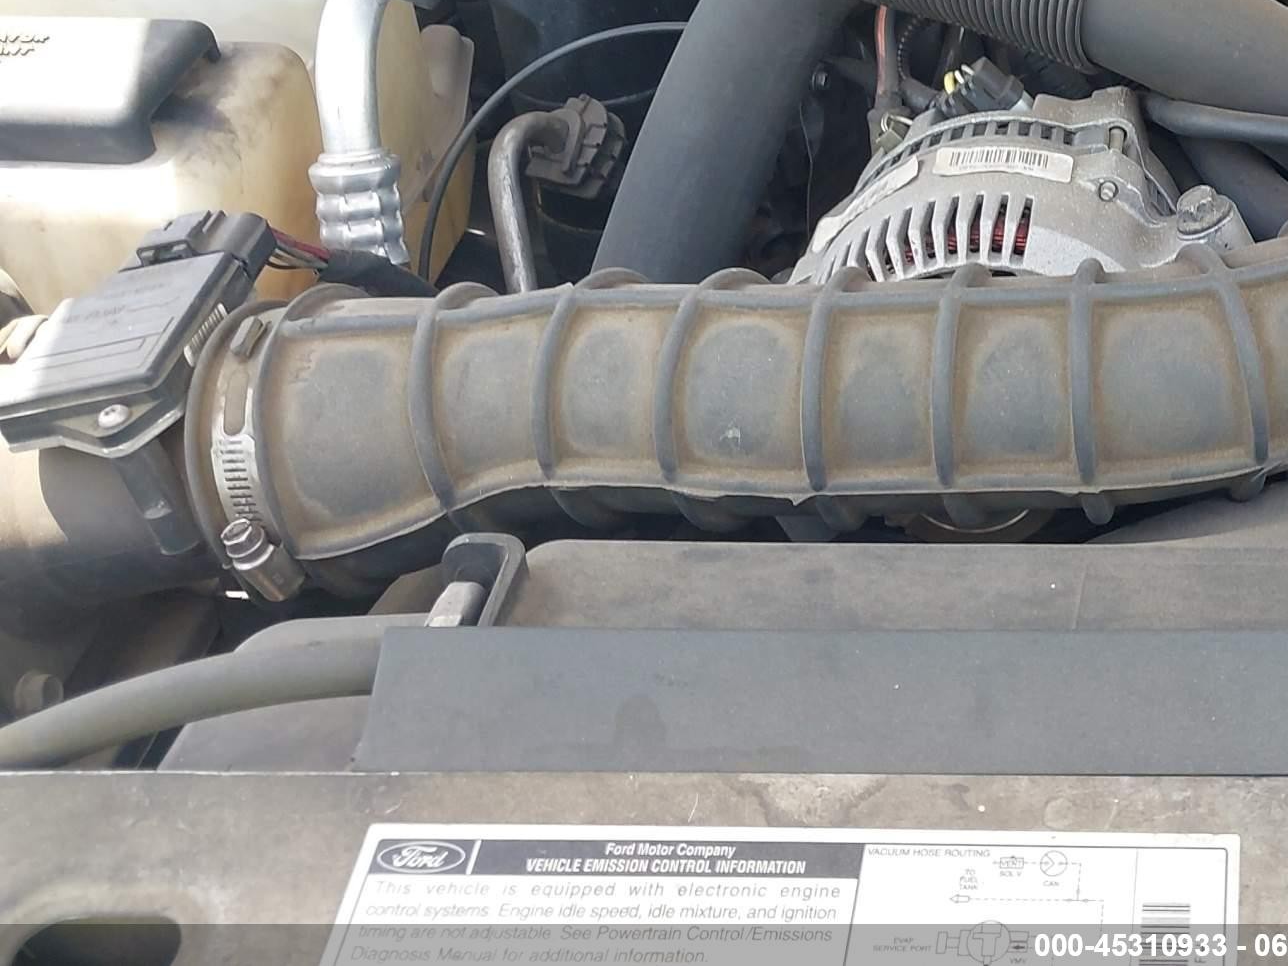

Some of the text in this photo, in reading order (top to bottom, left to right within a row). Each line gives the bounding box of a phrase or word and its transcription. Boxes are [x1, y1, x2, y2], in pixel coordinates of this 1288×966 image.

[392, 844, 449, 869] Ford
[605, 842, 736, 859] Ford Motor Company
[526, 858, 806, 875] VEHICLE EMISSION CONTROL INFORMATION
[376, 881, 841, 902] This vehicle is equipped with electronic engine
[366, 903, 421, 917] control
[498, 903, 553, 921] Engine
[557, 903, 586, 917] idle
[590, 904, 642, 921] speed,
[648, 904, 675, 918] idle
[746, 905, 777, 920] and
[780, 906, 837, 923] ignition
[357, 925, 405, 941] timing
[411, 928, 436, 940] are
[439, 926, 466, 940] not
[559, 925, 592, 941] See
[597, 925, 682, 941] Powertrain
[351, 945, 709, 964] Diagnosis Manual for additional information.
